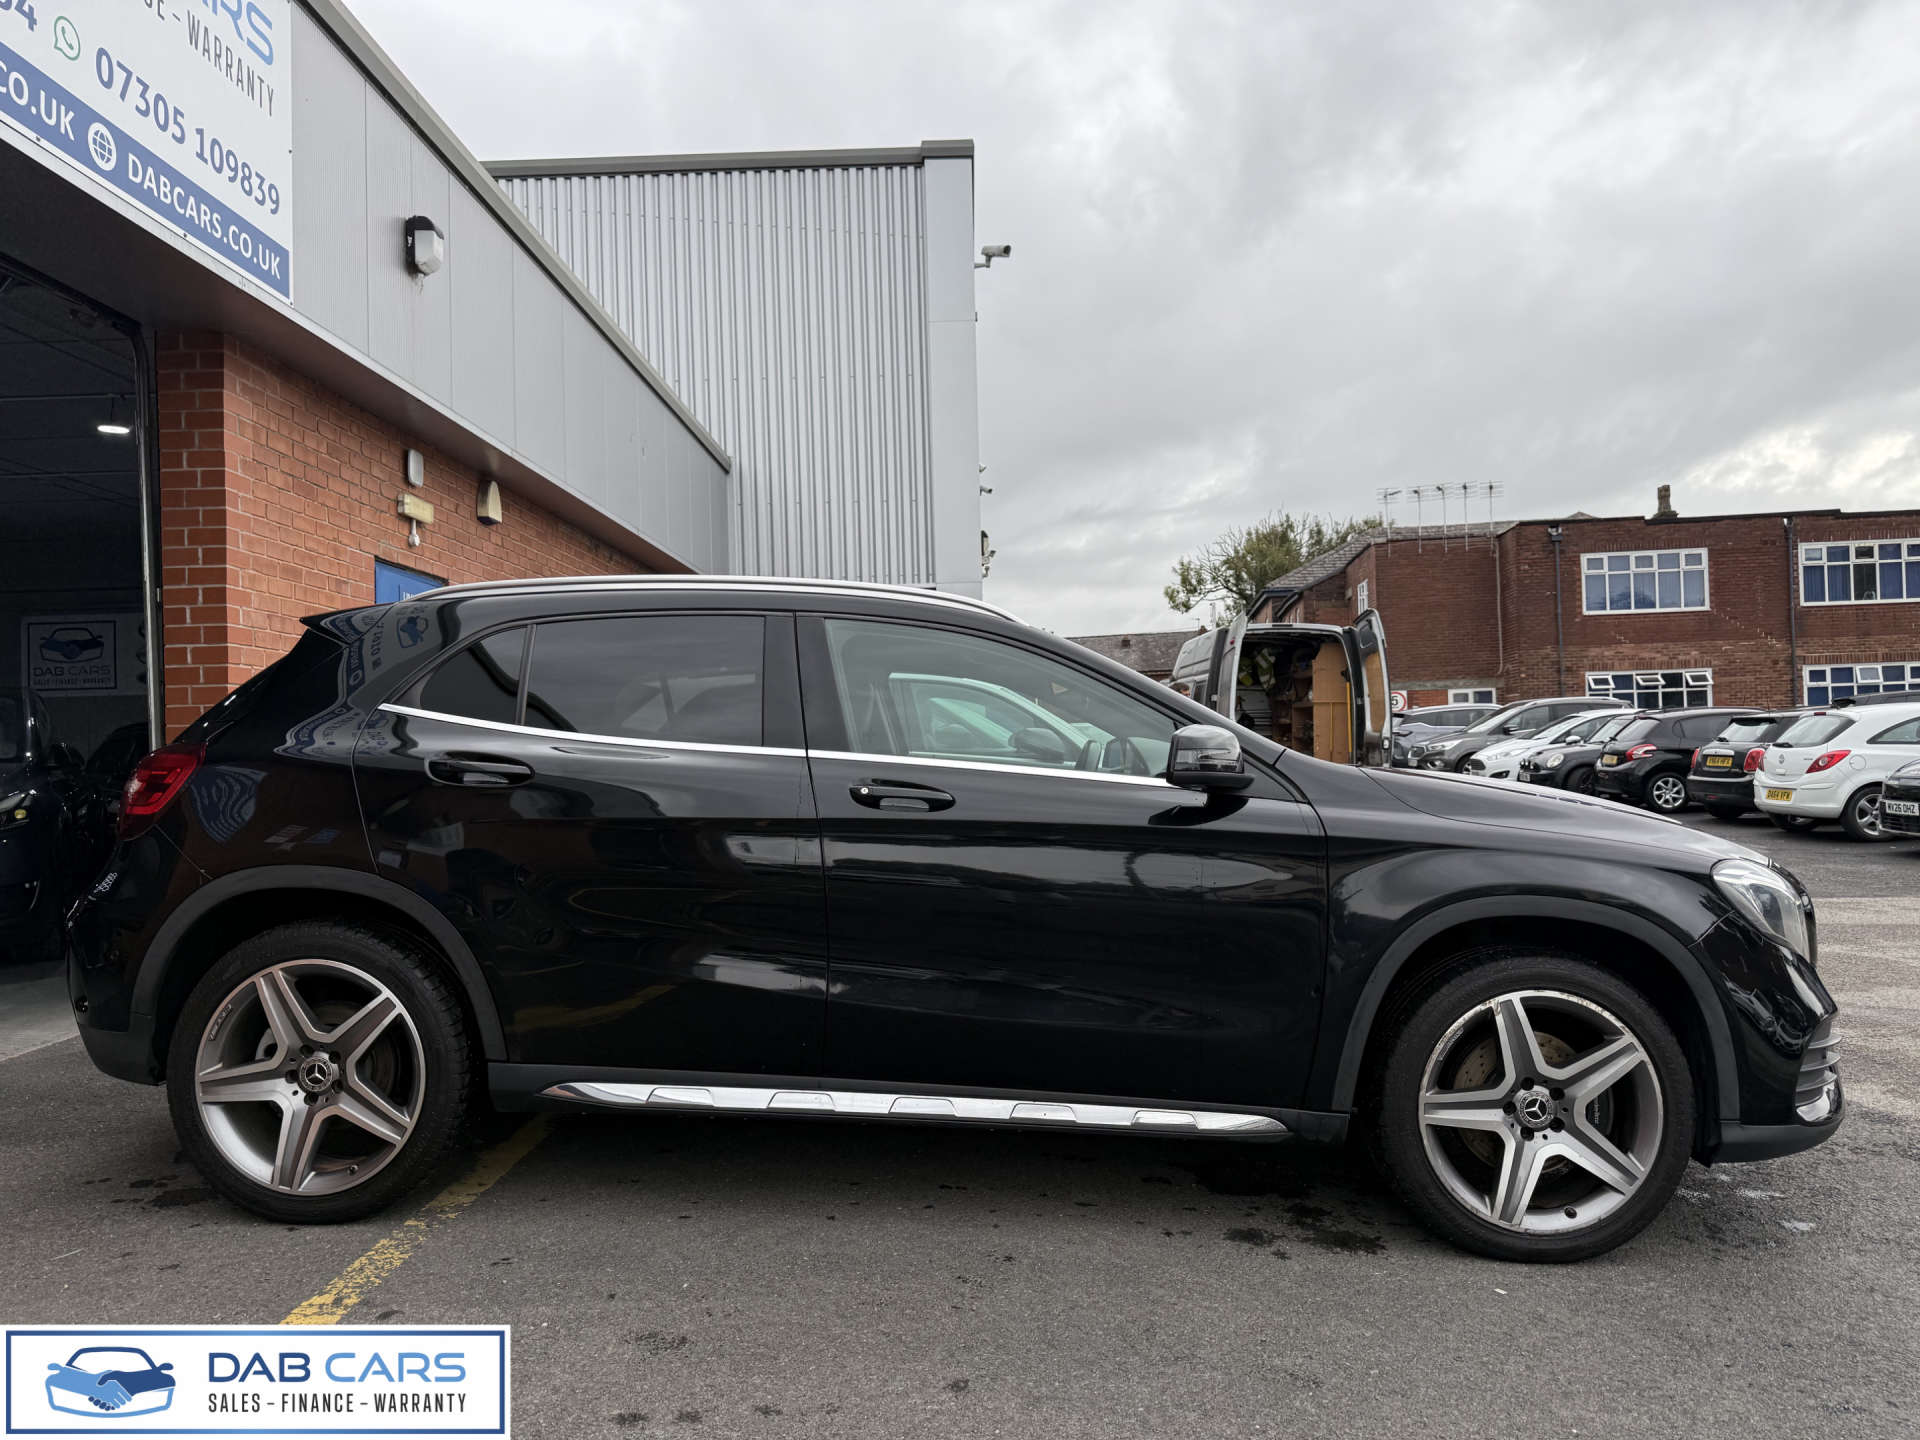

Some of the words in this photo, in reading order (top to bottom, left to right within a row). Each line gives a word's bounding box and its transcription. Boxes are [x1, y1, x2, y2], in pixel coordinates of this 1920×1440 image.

[187, 9, 274, 117] WARRANTY
[202, 0, 274, 66] RS
[95, 47, 186, 145] 07305
[195, 127, 280, 215] 109839
[127, 152, 281, 280] DABCARS.CO.UK
